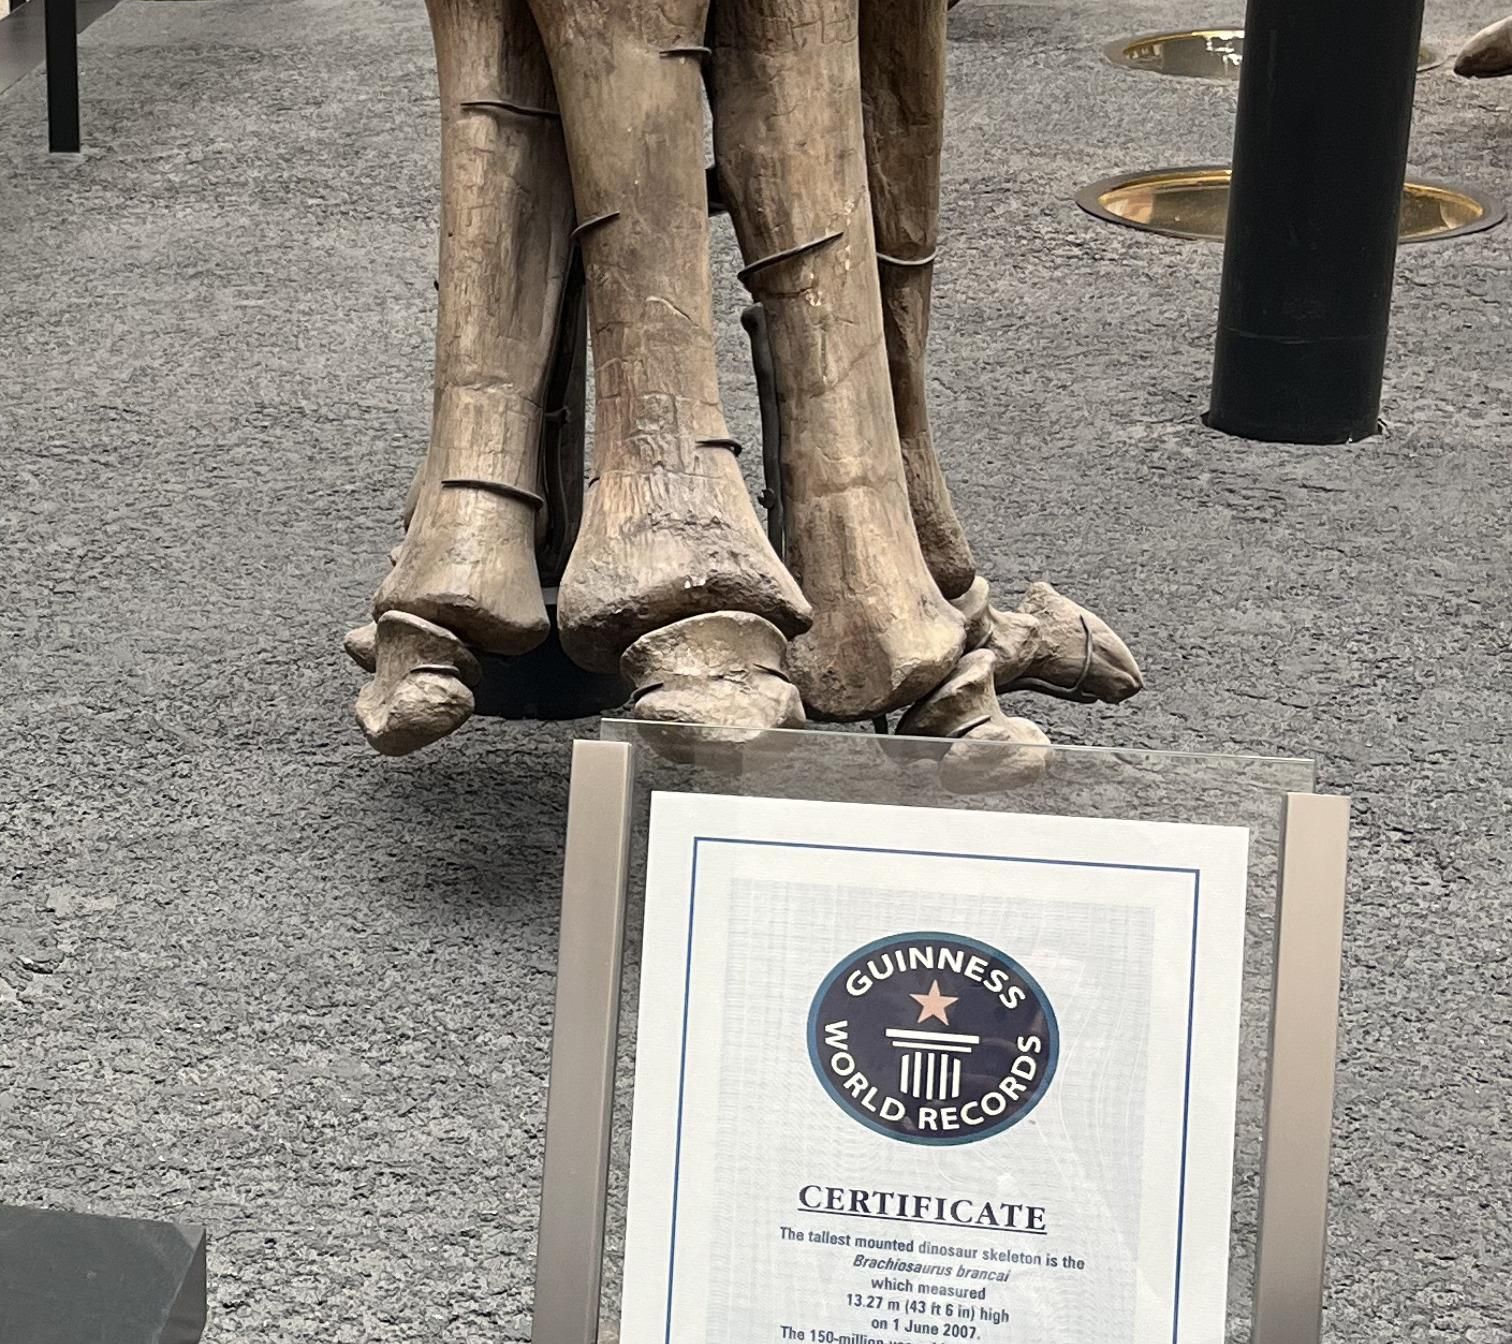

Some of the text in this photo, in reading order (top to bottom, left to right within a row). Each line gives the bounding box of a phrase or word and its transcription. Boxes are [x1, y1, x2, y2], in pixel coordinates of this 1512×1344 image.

[845, 946, 1027, 1010] GUINNESS
[824, 1020, 1042, 1131] WORLD RECORDS
[799, 1185, 1044, 1229] CERTIFICATE
[779, 1226, 1085, 1270] The tallest mounted dinosaur skeleton is the
[853, 1254, 1010, 1281] Brachiosaurus brancai
[870, 1276, 985, 1300] which measured
[846, 1293, 1009, 1324] 13.27 m (43 ft 6 in) high
[780, 1324, 804, 1340] The
[870, 1317, 980, 1339] on 1 June 2007.
